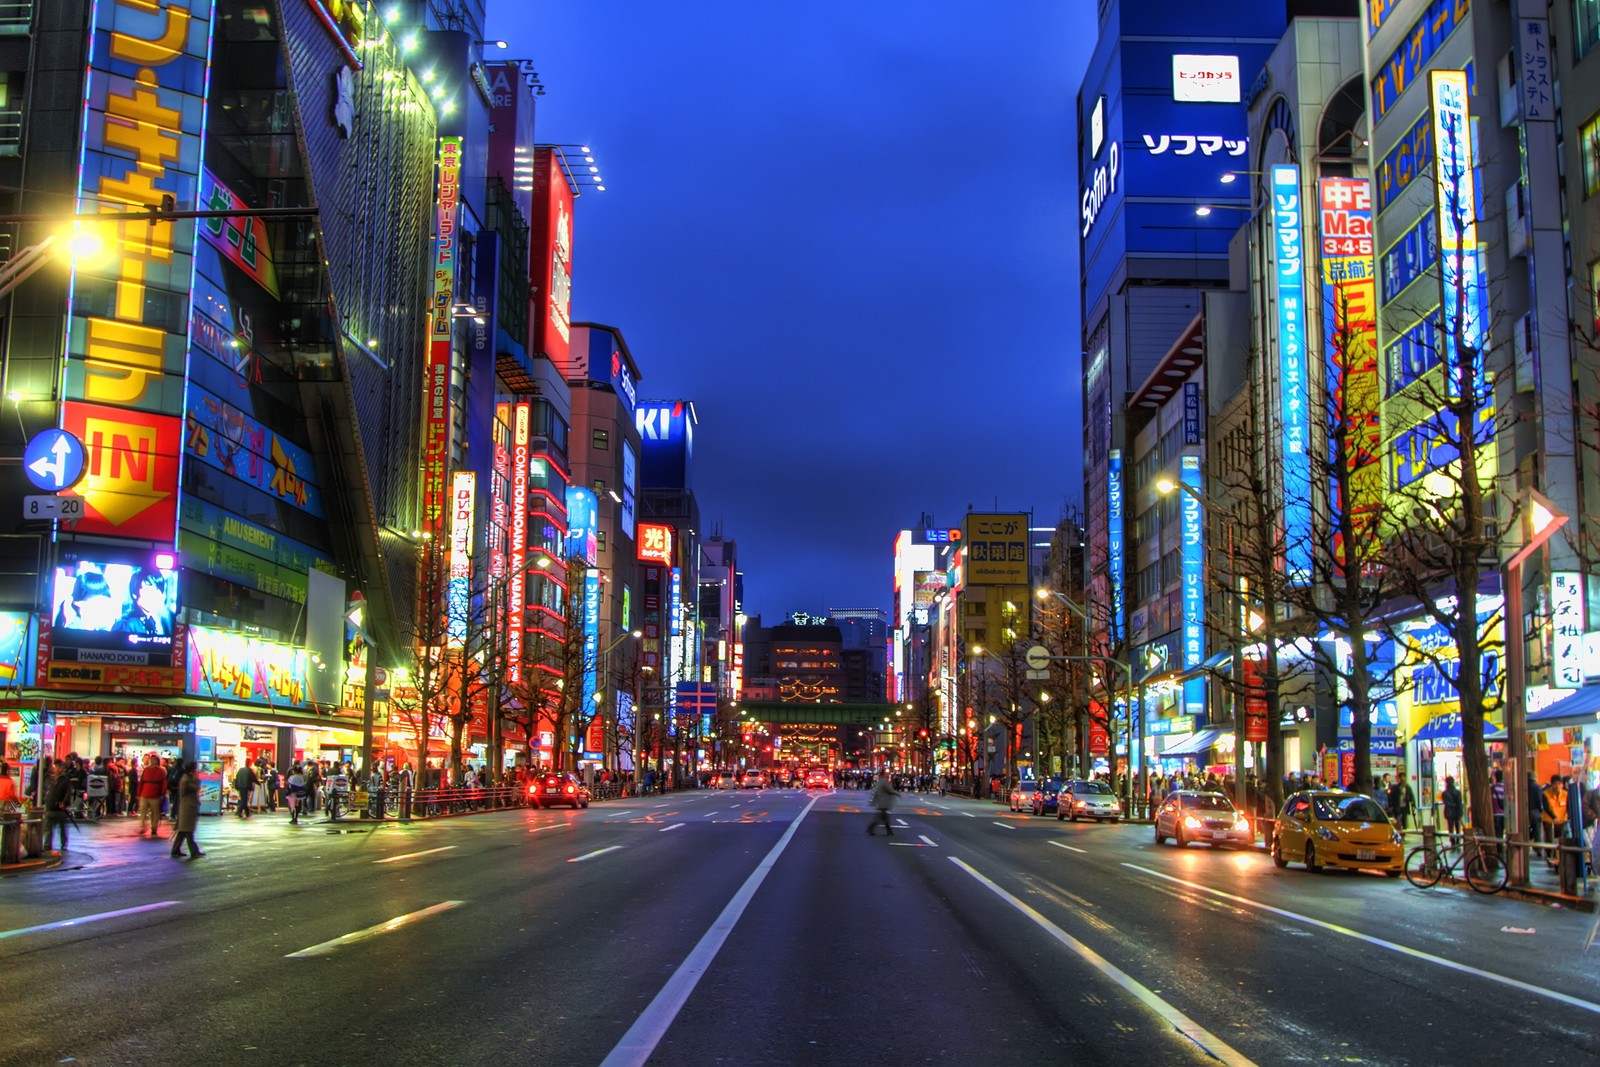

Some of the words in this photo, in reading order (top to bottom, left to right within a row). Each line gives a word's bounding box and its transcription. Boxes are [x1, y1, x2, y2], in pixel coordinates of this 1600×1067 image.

[1525, 52, 1539, 117] システム
[1142, 134, 1250, 156] ソフマッ
[440, 142, 457, 265] 東京レジャーランド
[1082, 141, 1119, 238] Sofmp
[1277, 193, 1302, 276] ソフマップ
[90, 431, 149, 483] IN
[30, 501, 39, 514] 8
[61, 500, 79, 513] 20
[513, 446, 527, 551] COMICTORANOANA
[223, 517, 275, 550] AMUSEMENT
[644, 528, 663, 549] 光
[978, 521, 1019, 535] ここが
[587, 584, 597, 624] ソフマップ
[80, 651, 117, 662] HANARO
[117, 653, 138, 662] DON
[137, 654, 146, 662] KI
[1412, 654, 1500, 706] TRAR
